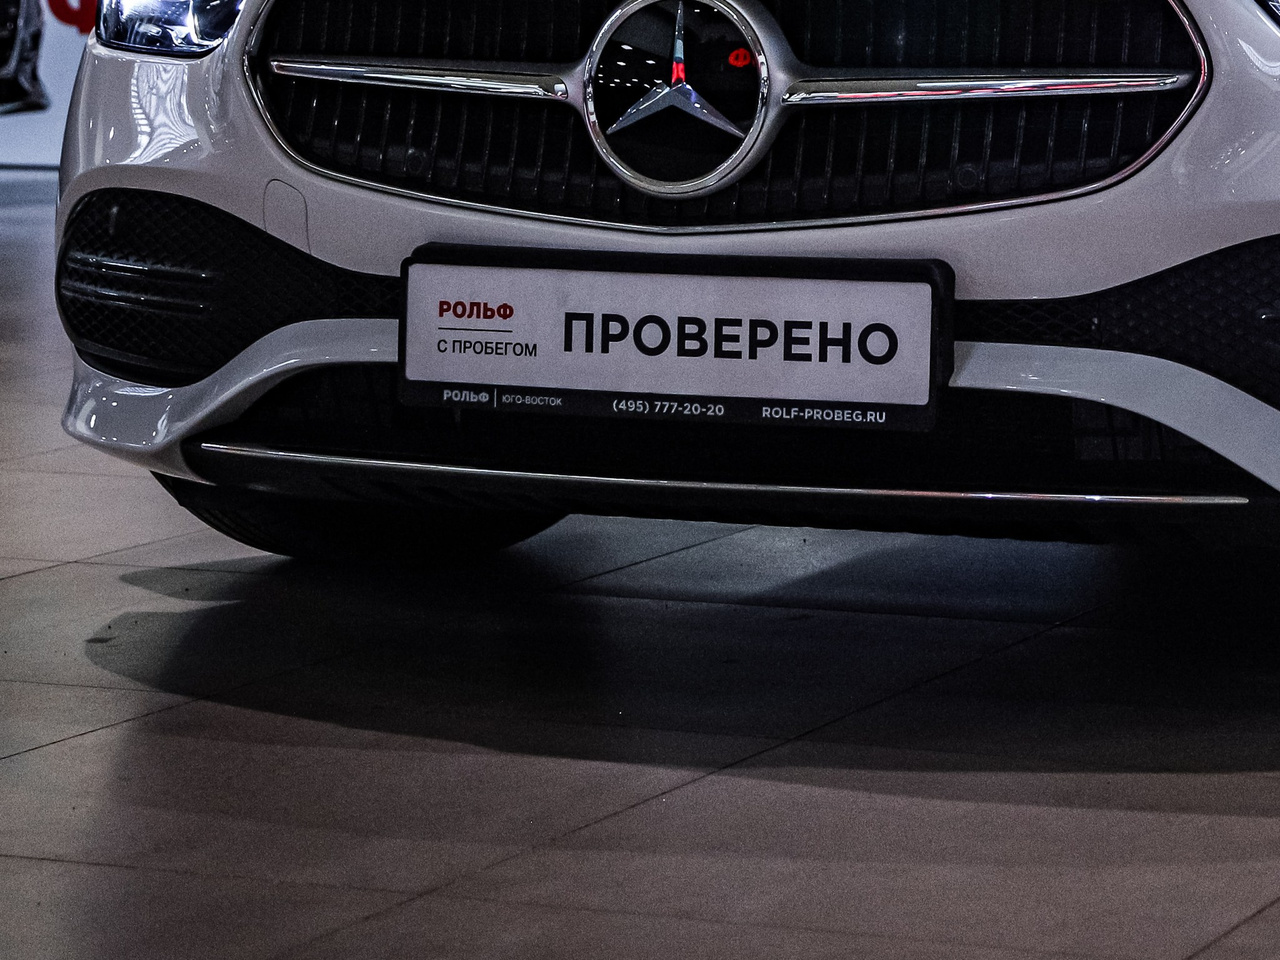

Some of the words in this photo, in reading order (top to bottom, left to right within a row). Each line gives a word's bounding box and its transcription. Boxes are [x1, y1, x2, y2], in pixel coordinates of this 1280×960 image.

[438, 300, 514, 320] РОЛЬФ
[563, 311, 899, 366] ПРОВЕРЕНО
[437, 339, 448, 353] С
[452, 340, 538, 357] ПРОБЕГОМ
[443, 389, 490, 403] РОЛЬФ
[502, 393, 562, 406] ЮГО-ВОСТОК
[612, 399, 650, 415] (495)
[653, 401, 725, 416] 777-20-20
[761, 406, 887, 424] ROLF-PROBEG.RU
